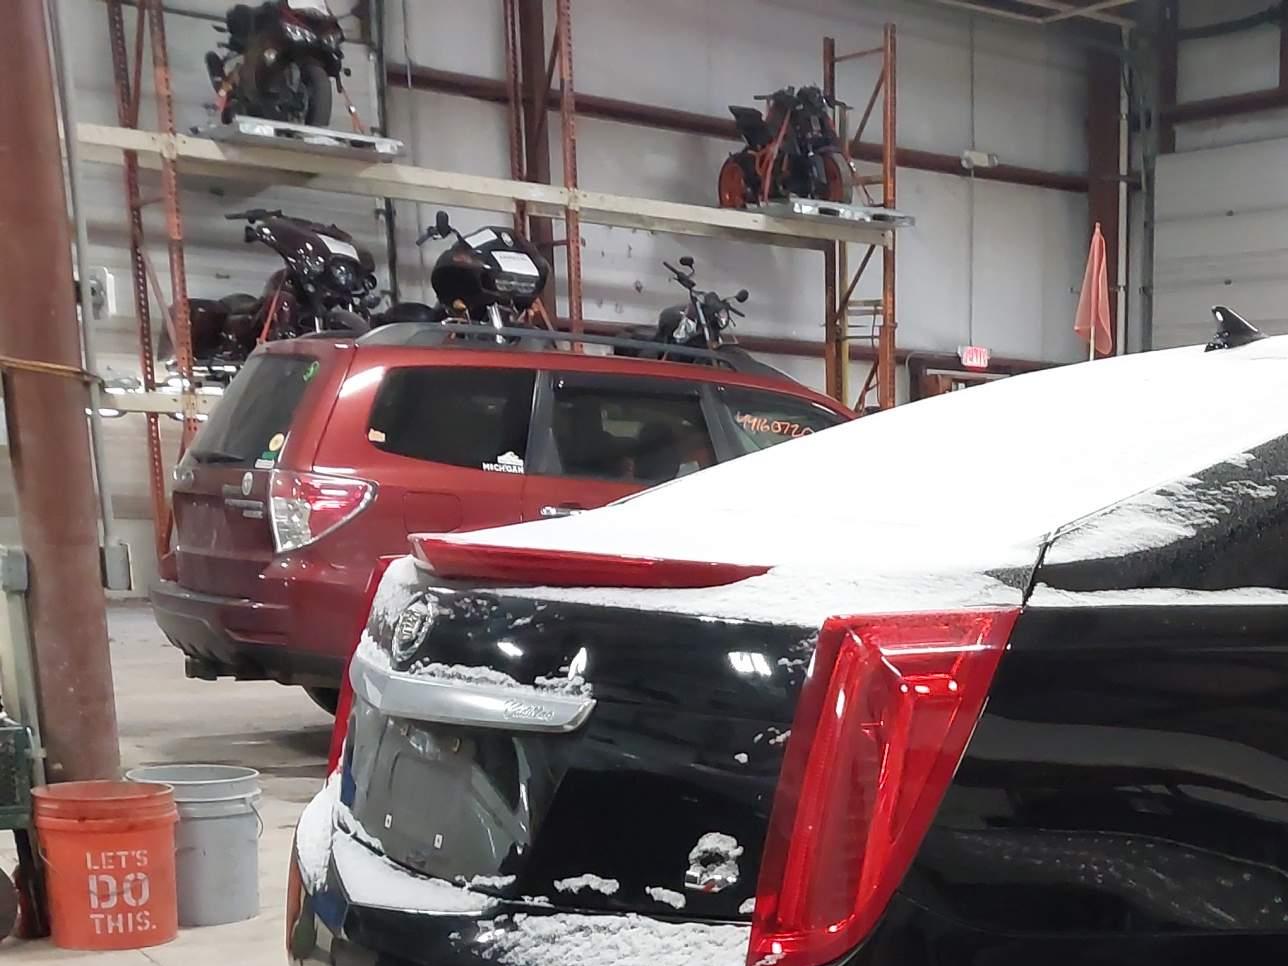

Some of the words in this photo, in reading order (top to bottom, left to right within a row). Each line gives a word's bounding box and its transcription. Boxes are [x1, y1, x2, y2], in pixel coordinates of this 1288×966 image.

[86, 849, 149, 869] LET'S
[88, 873, 150, 909] DO
[88, 911, 158, 934] THIS.
